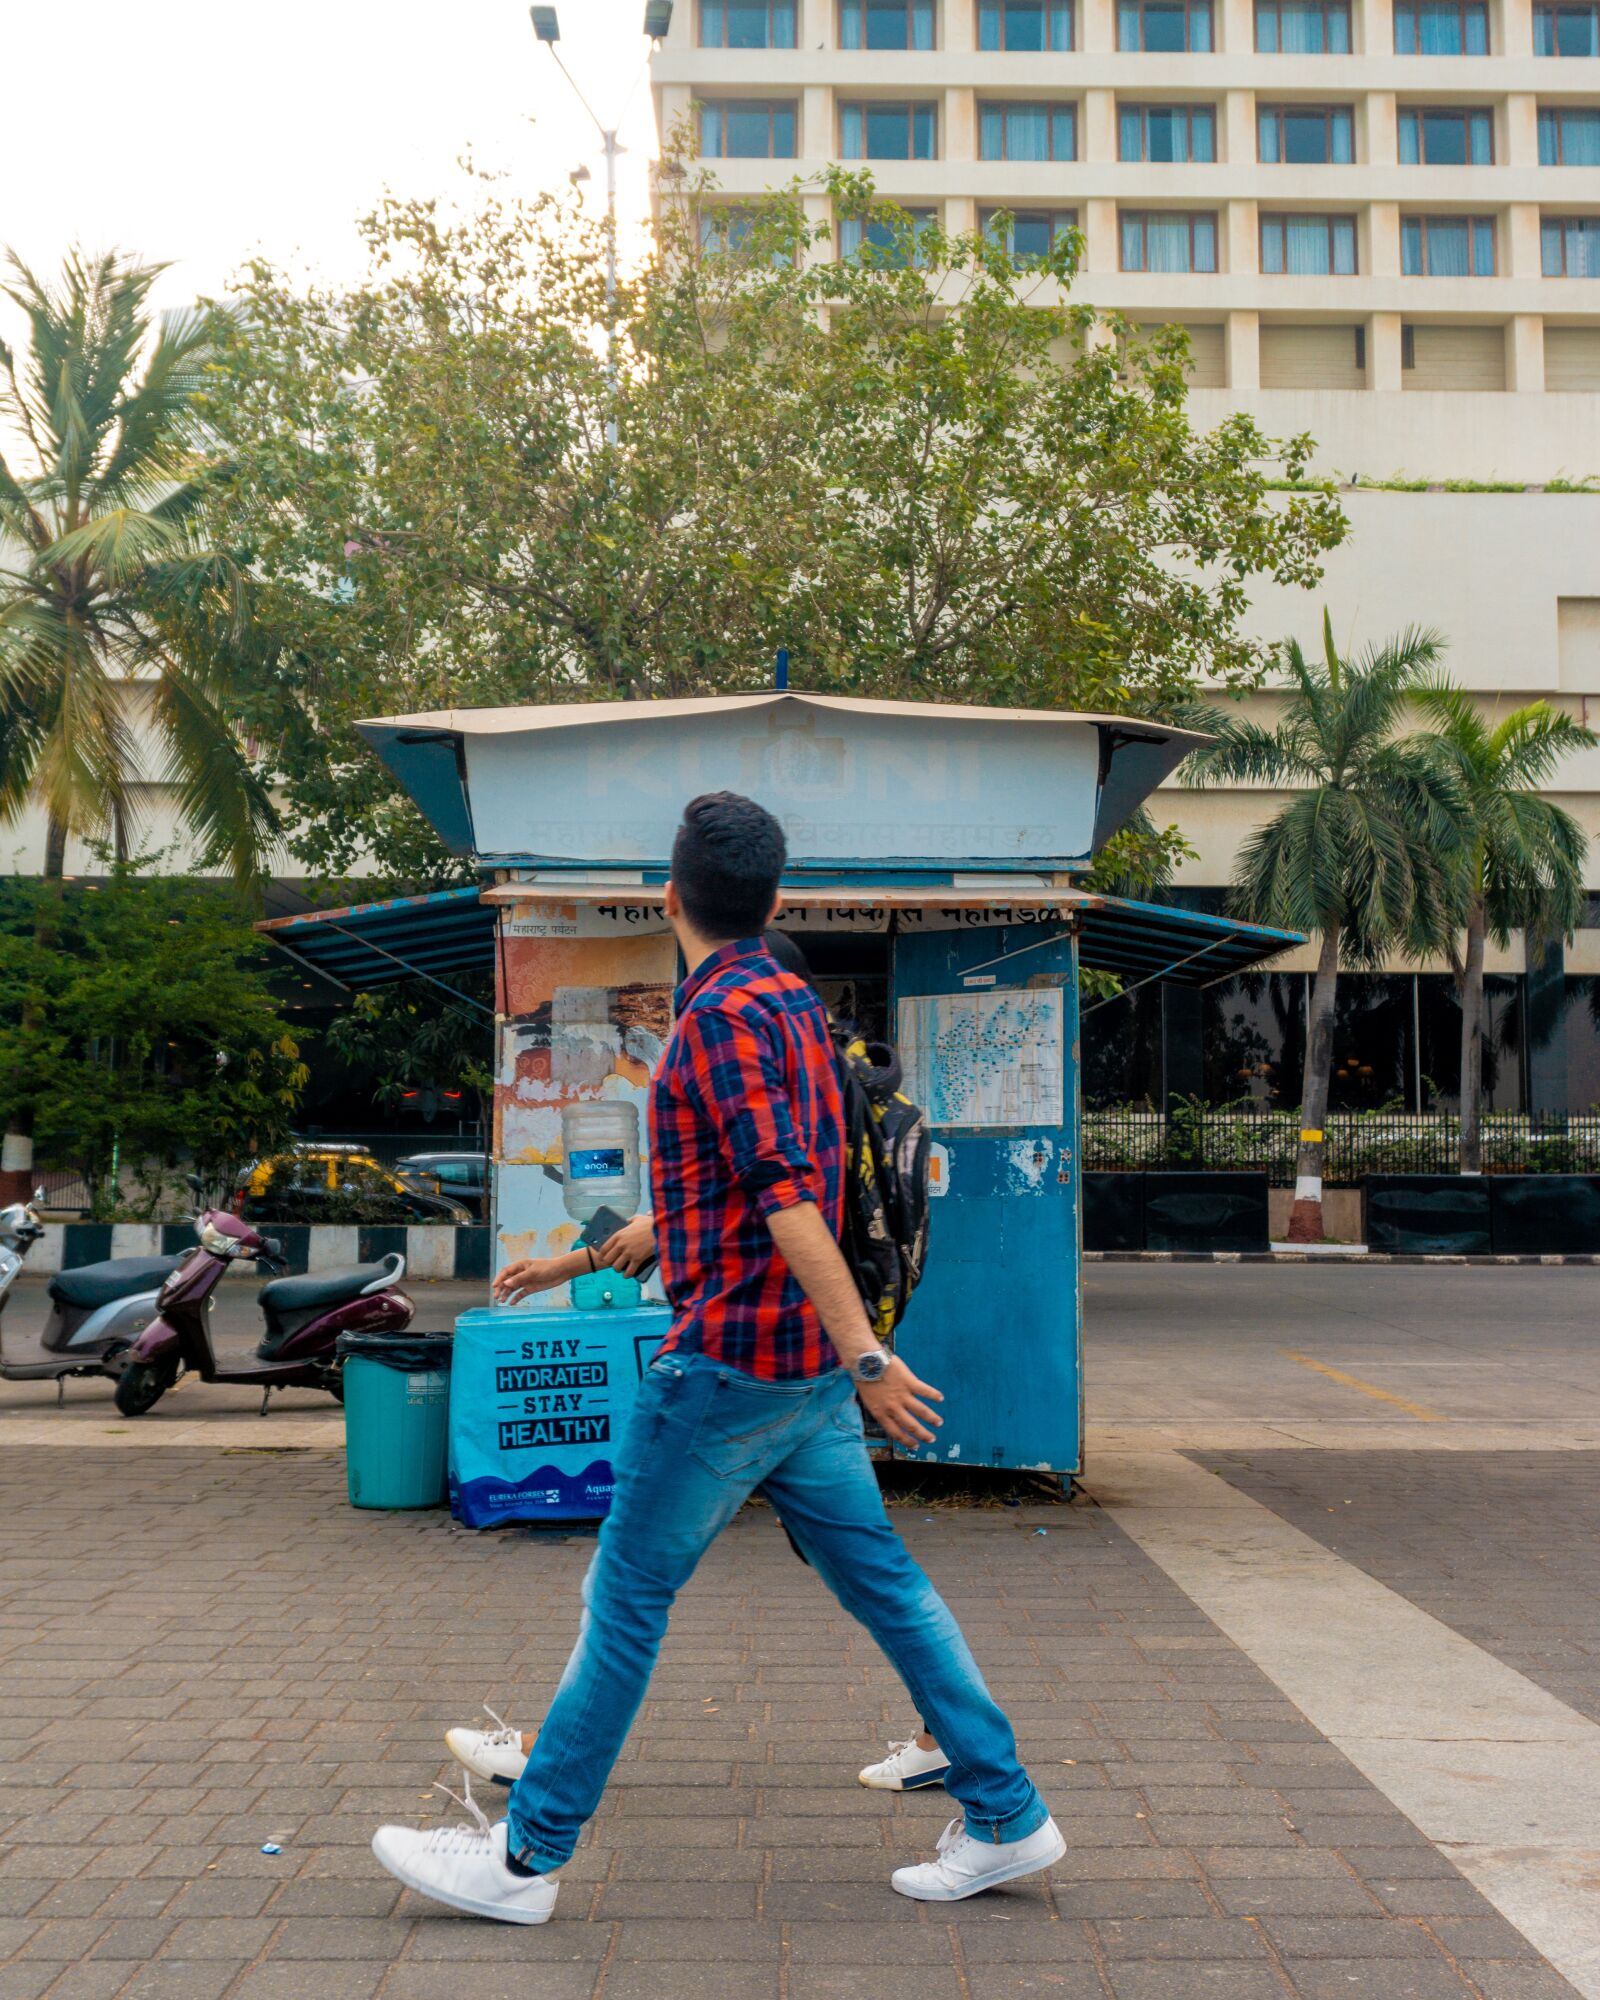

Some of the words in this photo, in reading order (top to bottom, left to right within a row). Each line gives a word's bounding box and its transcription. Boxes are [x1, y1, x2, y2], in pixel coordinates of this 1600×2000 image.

[521, 1339, 581, 1360] STAY
[499, 1365, 605, 1389] HYDRATED
[523, 1393, 583, 1414] STAY
[501, 1418, 607, 1447] HEALTHY
[488, 1492, 517, 1502] EUREKA
[585, 1484, 617, 1496] Aquag
